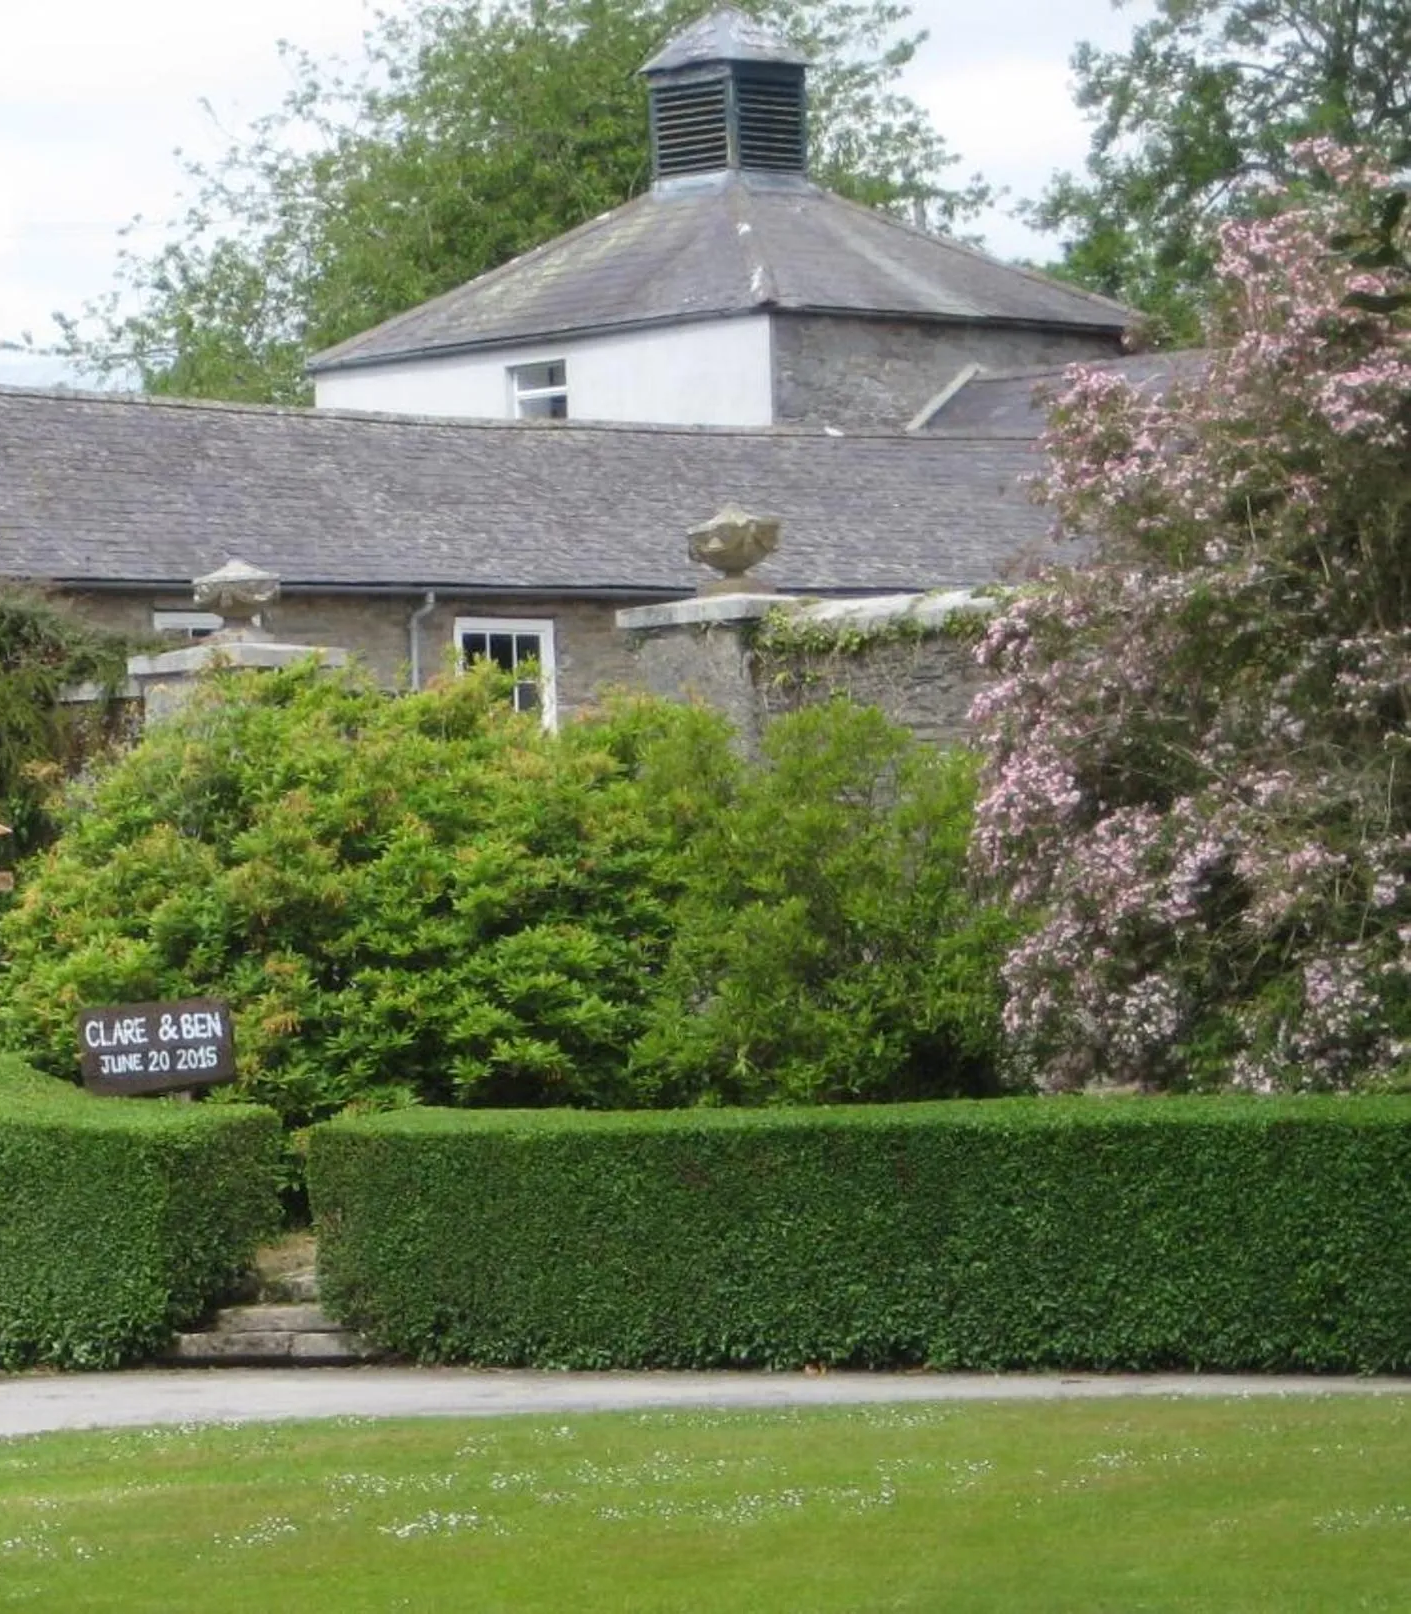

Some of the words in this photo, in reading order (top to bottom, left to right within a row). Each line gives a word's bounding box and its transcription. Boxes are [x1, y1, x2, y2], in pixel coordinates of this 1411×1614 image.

[85, 1016, 149, 1048] CLARE
[158, 1013, 179, 1042] &
[180, 1011, 223, 1040] BEN
[99, 1053, 144, 1074] JUNE
[148, 1050, 170, 1072] 20
[176, 1046, 218, 1070] 2015
